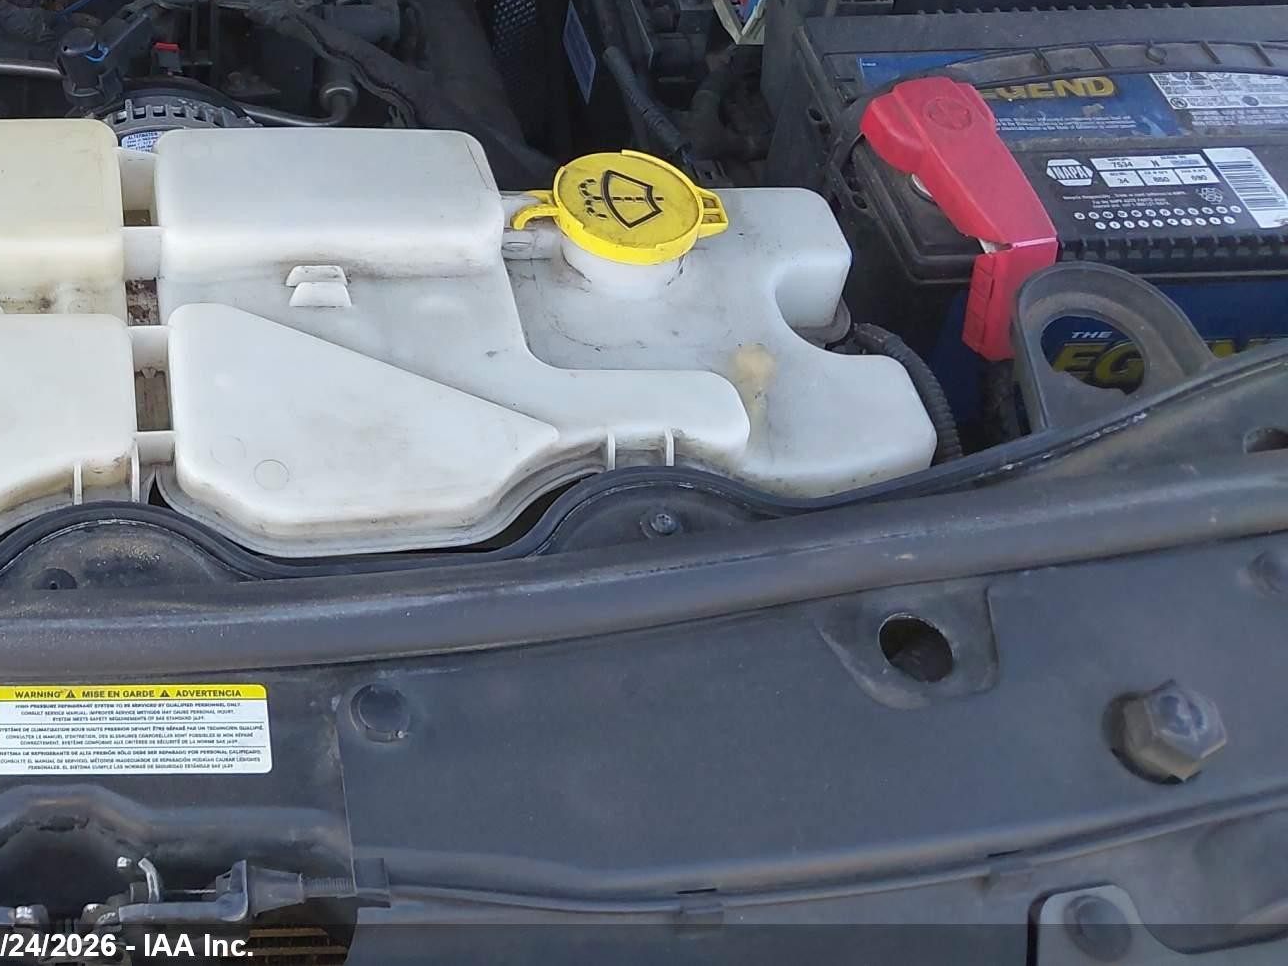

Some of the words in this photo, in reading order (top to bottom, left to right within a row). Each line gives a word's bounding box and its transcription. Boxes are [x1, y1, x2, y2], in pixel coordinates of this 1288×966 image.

[1052, 164, 1088, 181] NAPA
[1071, 330, 1113, 339] THE
[15, 690, 62, 699] WARNING
[82, 690, 106, 698] MISE
[108, 690, 121, 698] EN
[123, 690, 155, 698] GARDE
[175, 689, 242, 698] ADVERTENCIA
